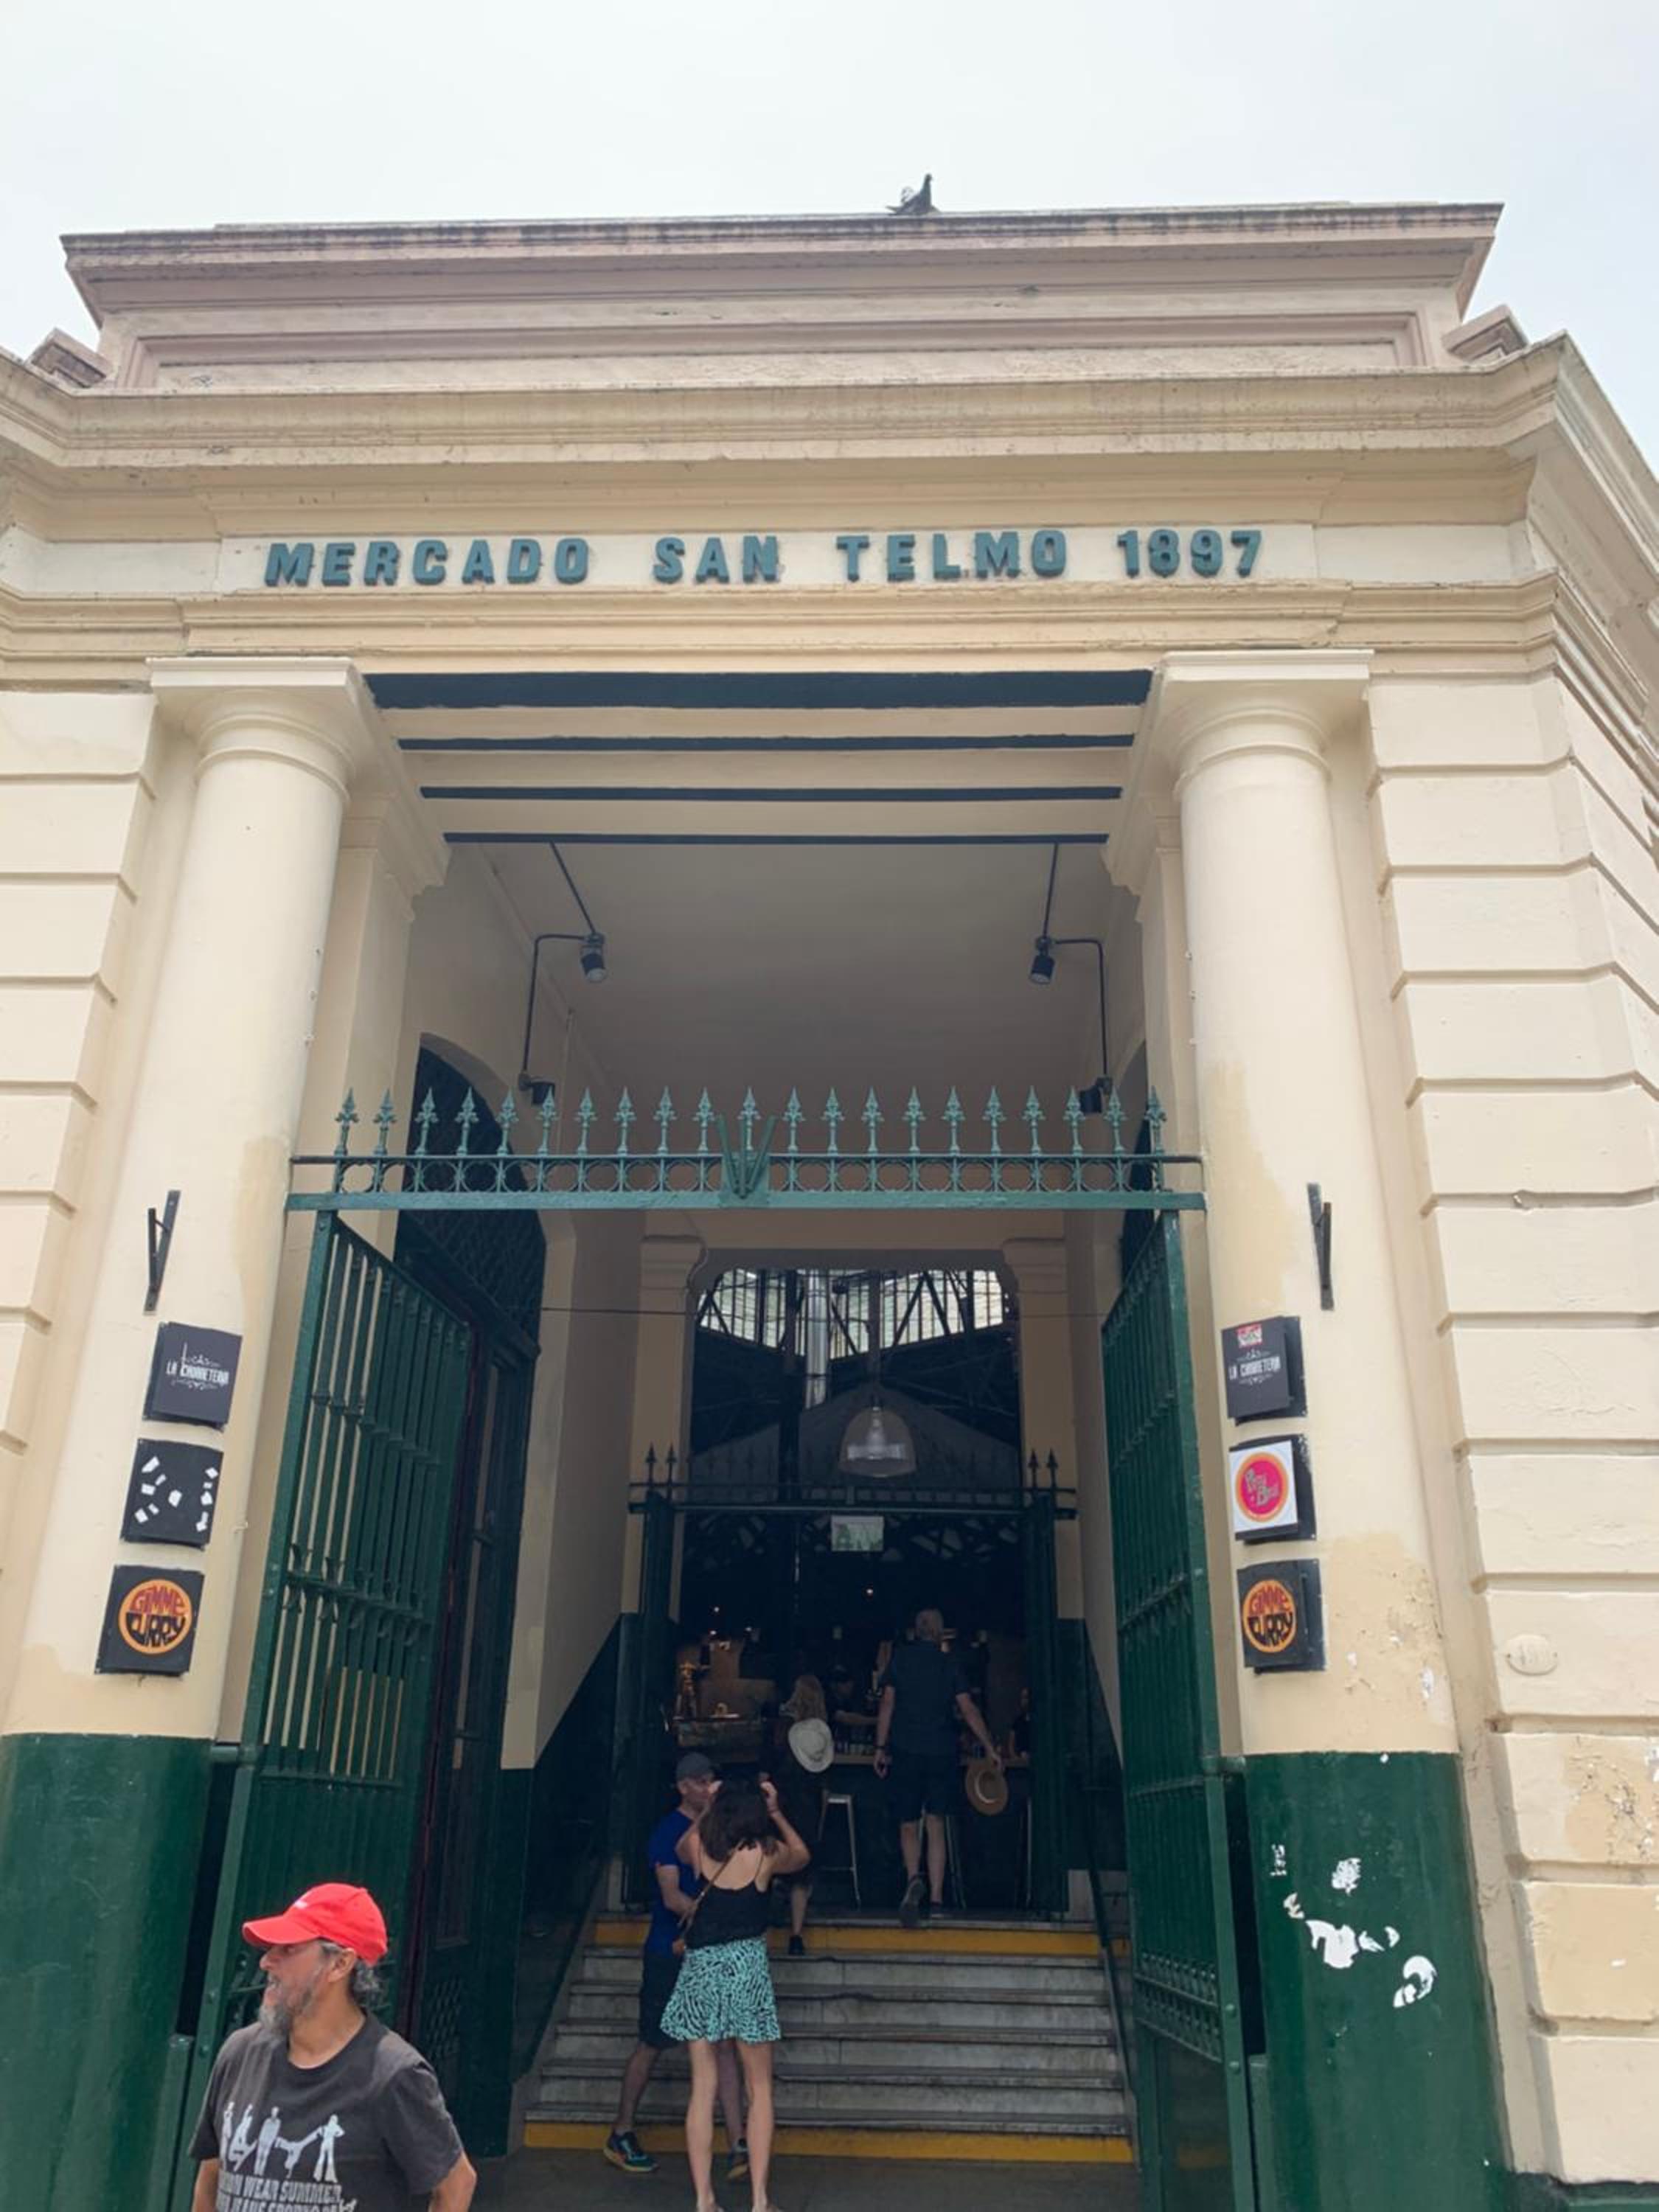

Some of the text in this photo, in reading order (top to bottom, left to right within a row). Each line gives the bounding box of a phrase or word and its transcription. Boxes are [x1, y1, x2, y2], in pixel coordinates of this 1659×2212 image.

[264, 529, 1262, 587] MERCADO SAN TELMO 1897
